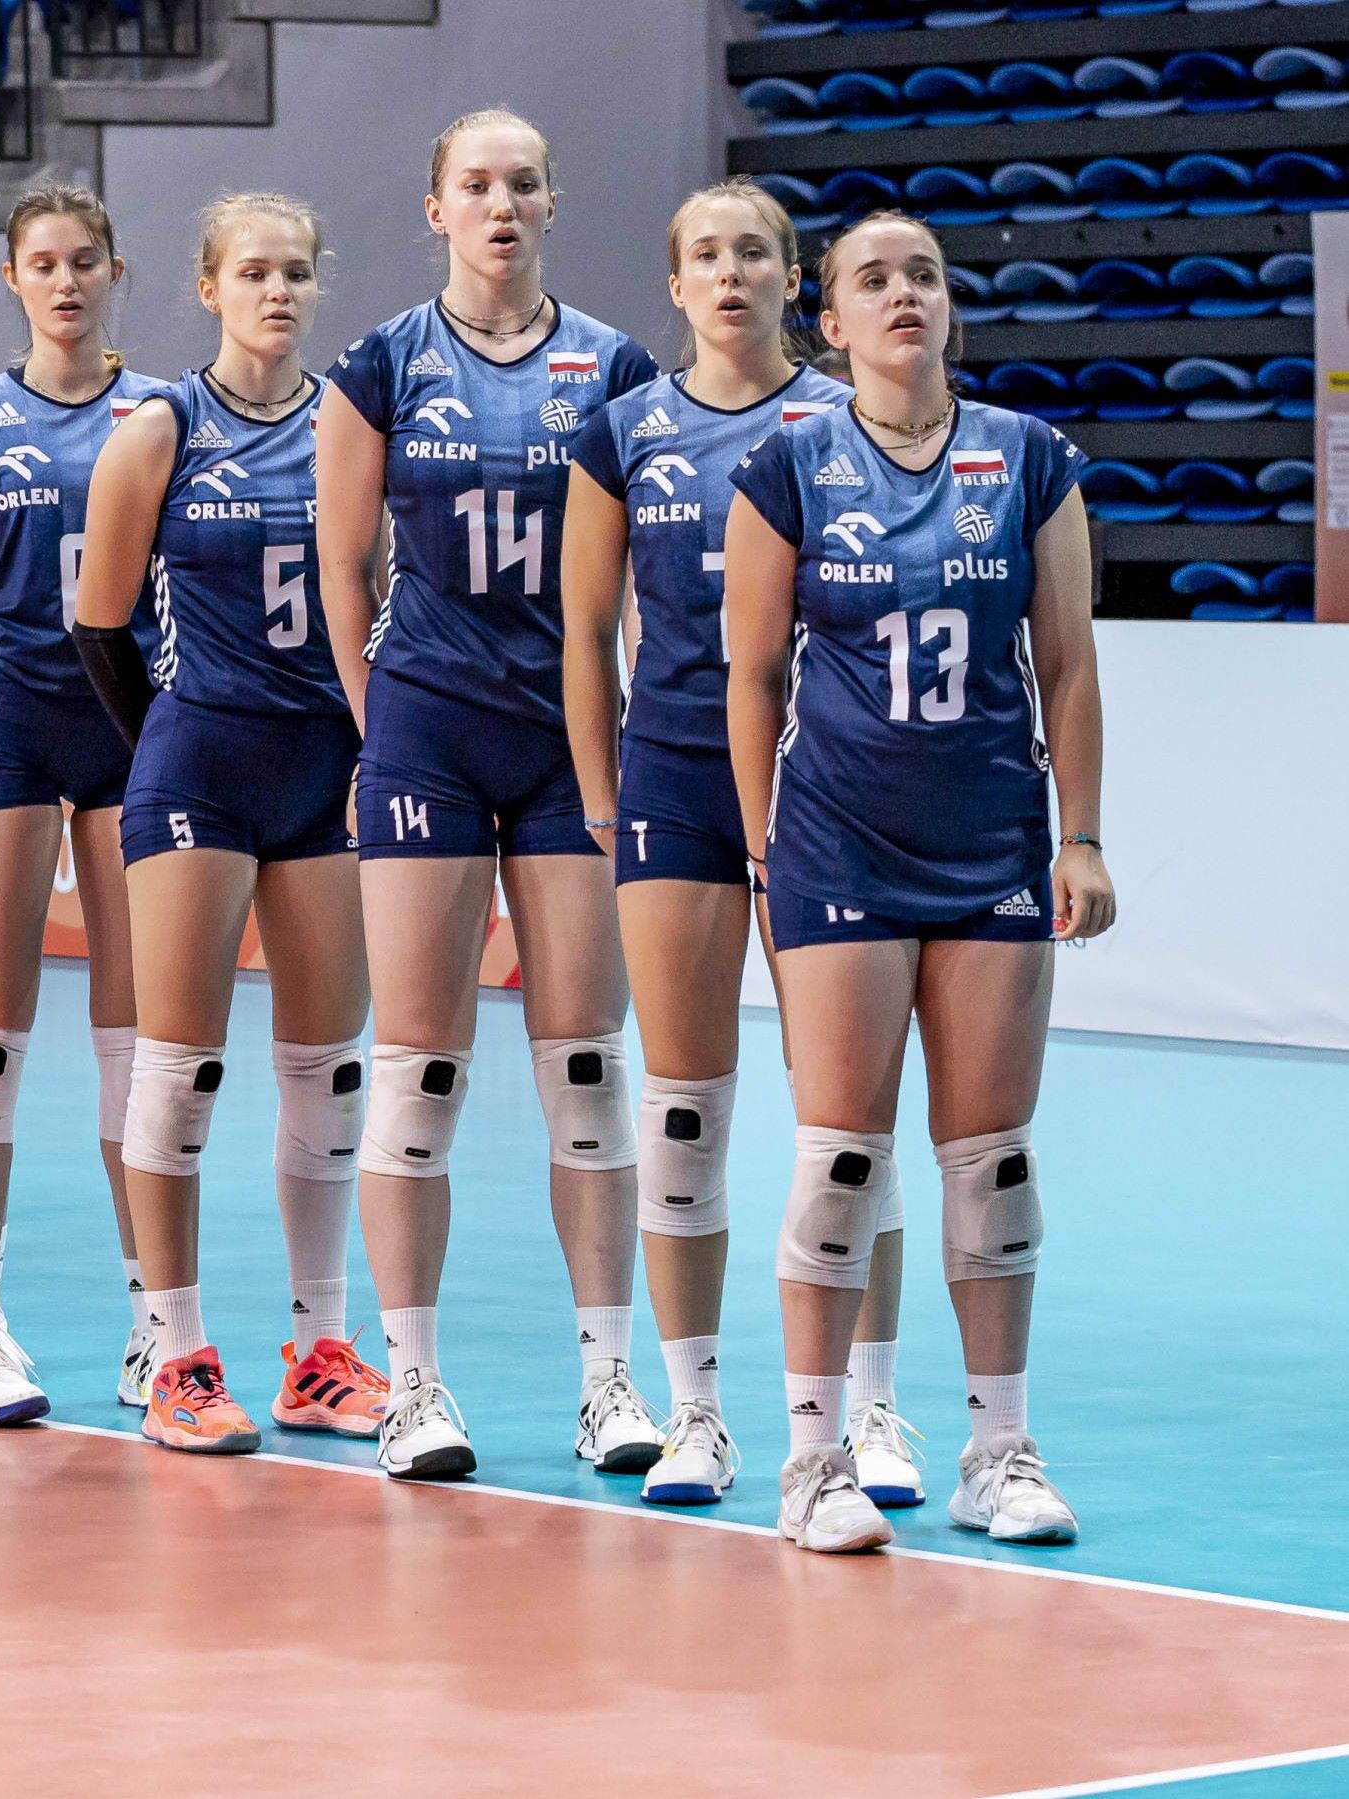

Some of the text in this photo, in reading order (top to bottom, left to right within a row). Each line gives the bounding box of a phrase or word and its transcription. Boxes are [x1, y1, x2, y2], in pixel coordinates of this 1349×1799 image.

[548, 371, 600, 383] POLSKA
[405, 440, 477, 461] ORLEN
[526, 440, 570, 470] plu
[953, 473, 1010, 487] POLSKA
[186, 502, 260, 520] ORLEN
[636, 504, 701, 525] ORLEN
[453, 488, 544, 595] 14
[819, 562, 893, 584] ORLEN
[943, 552, 1009, 586] plus
[263, 544, 308, 649] 5
[875, 608, 970, 723] 13
[168, 812, 195, 850] 5
[389, 795, 431, 841] 14
